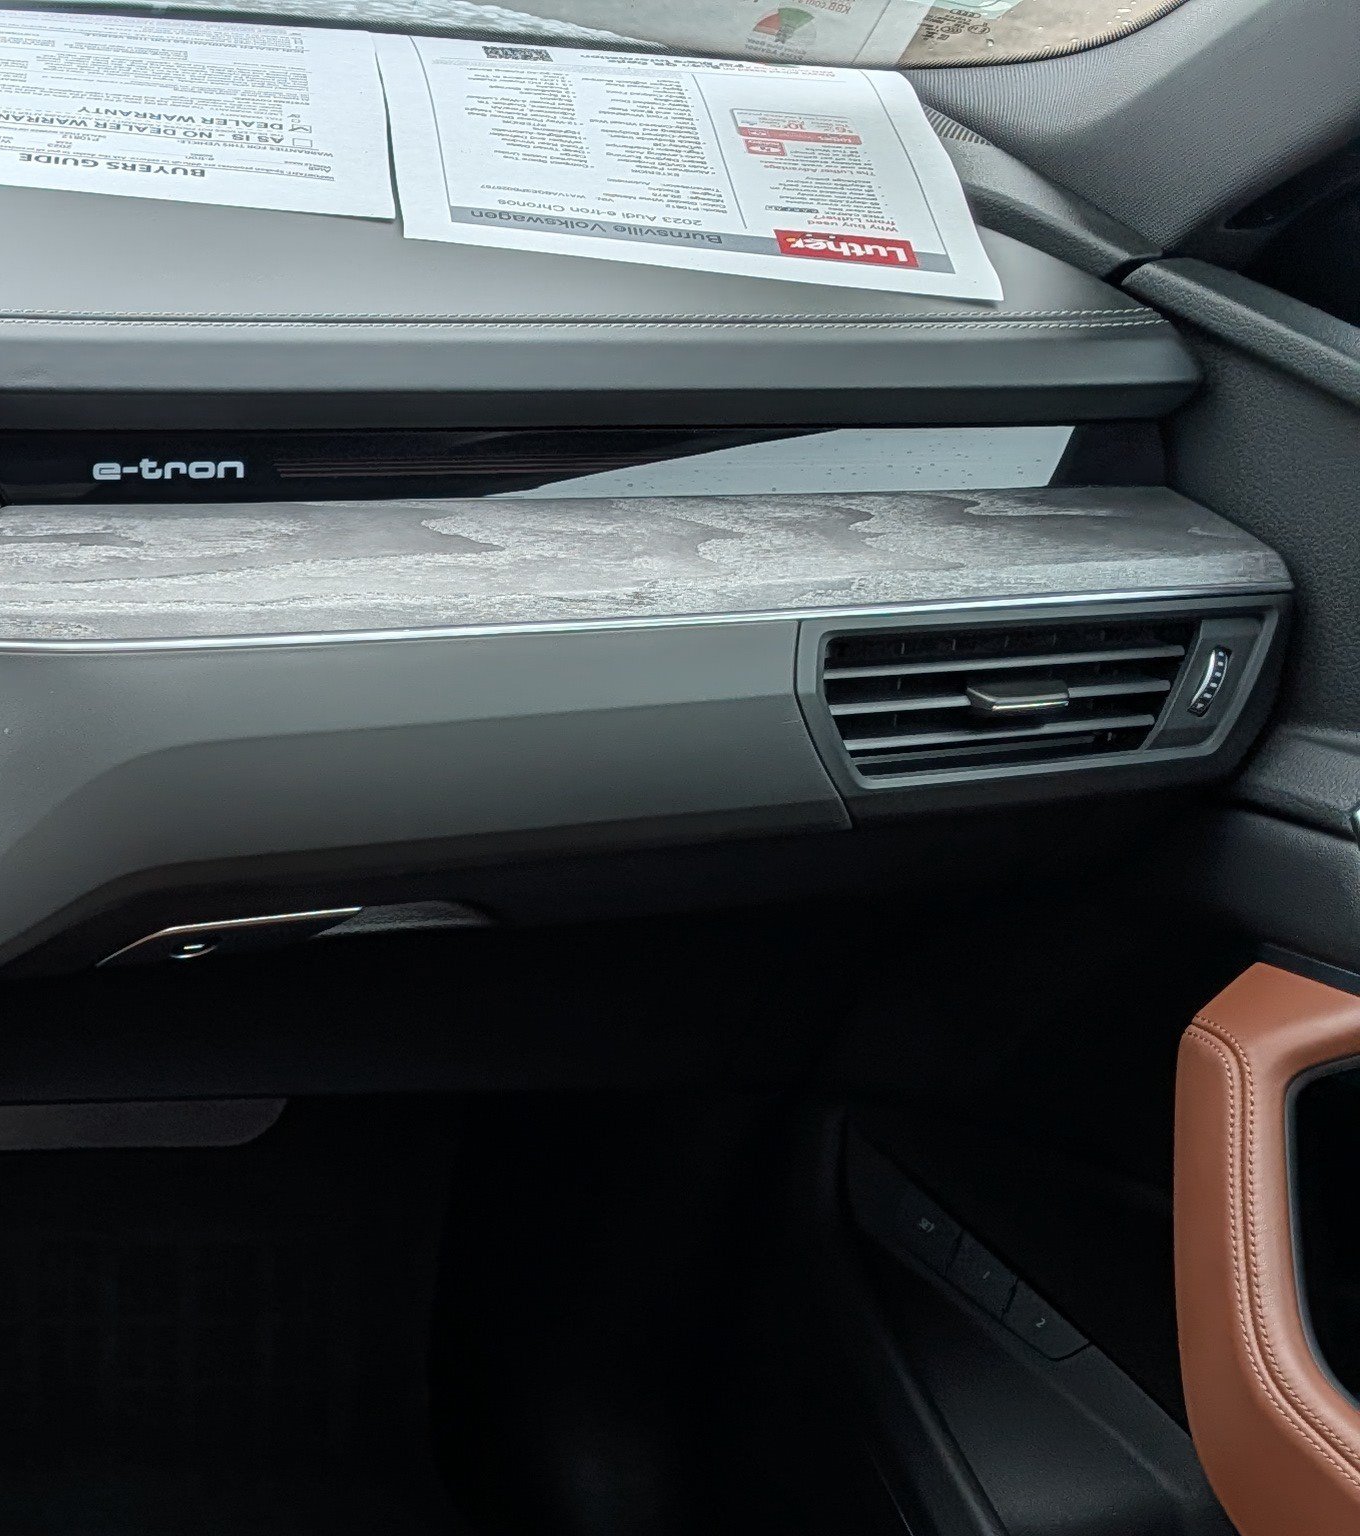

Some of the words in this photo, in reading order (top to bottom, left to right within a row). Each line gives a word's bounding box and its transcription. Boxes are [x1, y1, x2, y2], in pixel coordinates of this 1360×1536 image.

[77, 106, 196, 123] WARRANTY
[95, 121, 176, 136] DEALER
[201, 116, 284, 131] DEALER
[182, 130, 212, 139] NO
[231, 133, 250, 142] IS
[257, 135, 284, 144] AS
[269, 146, 334, 157] WARRANTIES
[19, 152, 99, 168] GUIDE
[106, 161, 205, 178] BUYERS
[764, 164, 818, 173] Advantage
[821, 167, 853, 175] Luther
[856, 169, 876, 177] The
[497, 198, 565, 212] Chronos
[570, 205, 616, 216] e-tron
[470, 209, 607, 234] Volkswagen
[622, 212, 657, 222] Audi
[662, 216, 702, 226] 2023
[813, 214, 862, 223] Luther?
[867, 218, 896, 226] from
[807, 219, 839, 227] used
[842, 220, 867, 230] buy
[869, 222, 898, 232] Why
[612, 225, 723, 245] Burnsville
[790, 235, 908, 263] Luther
[92, 458, 245, 481] e-tron
